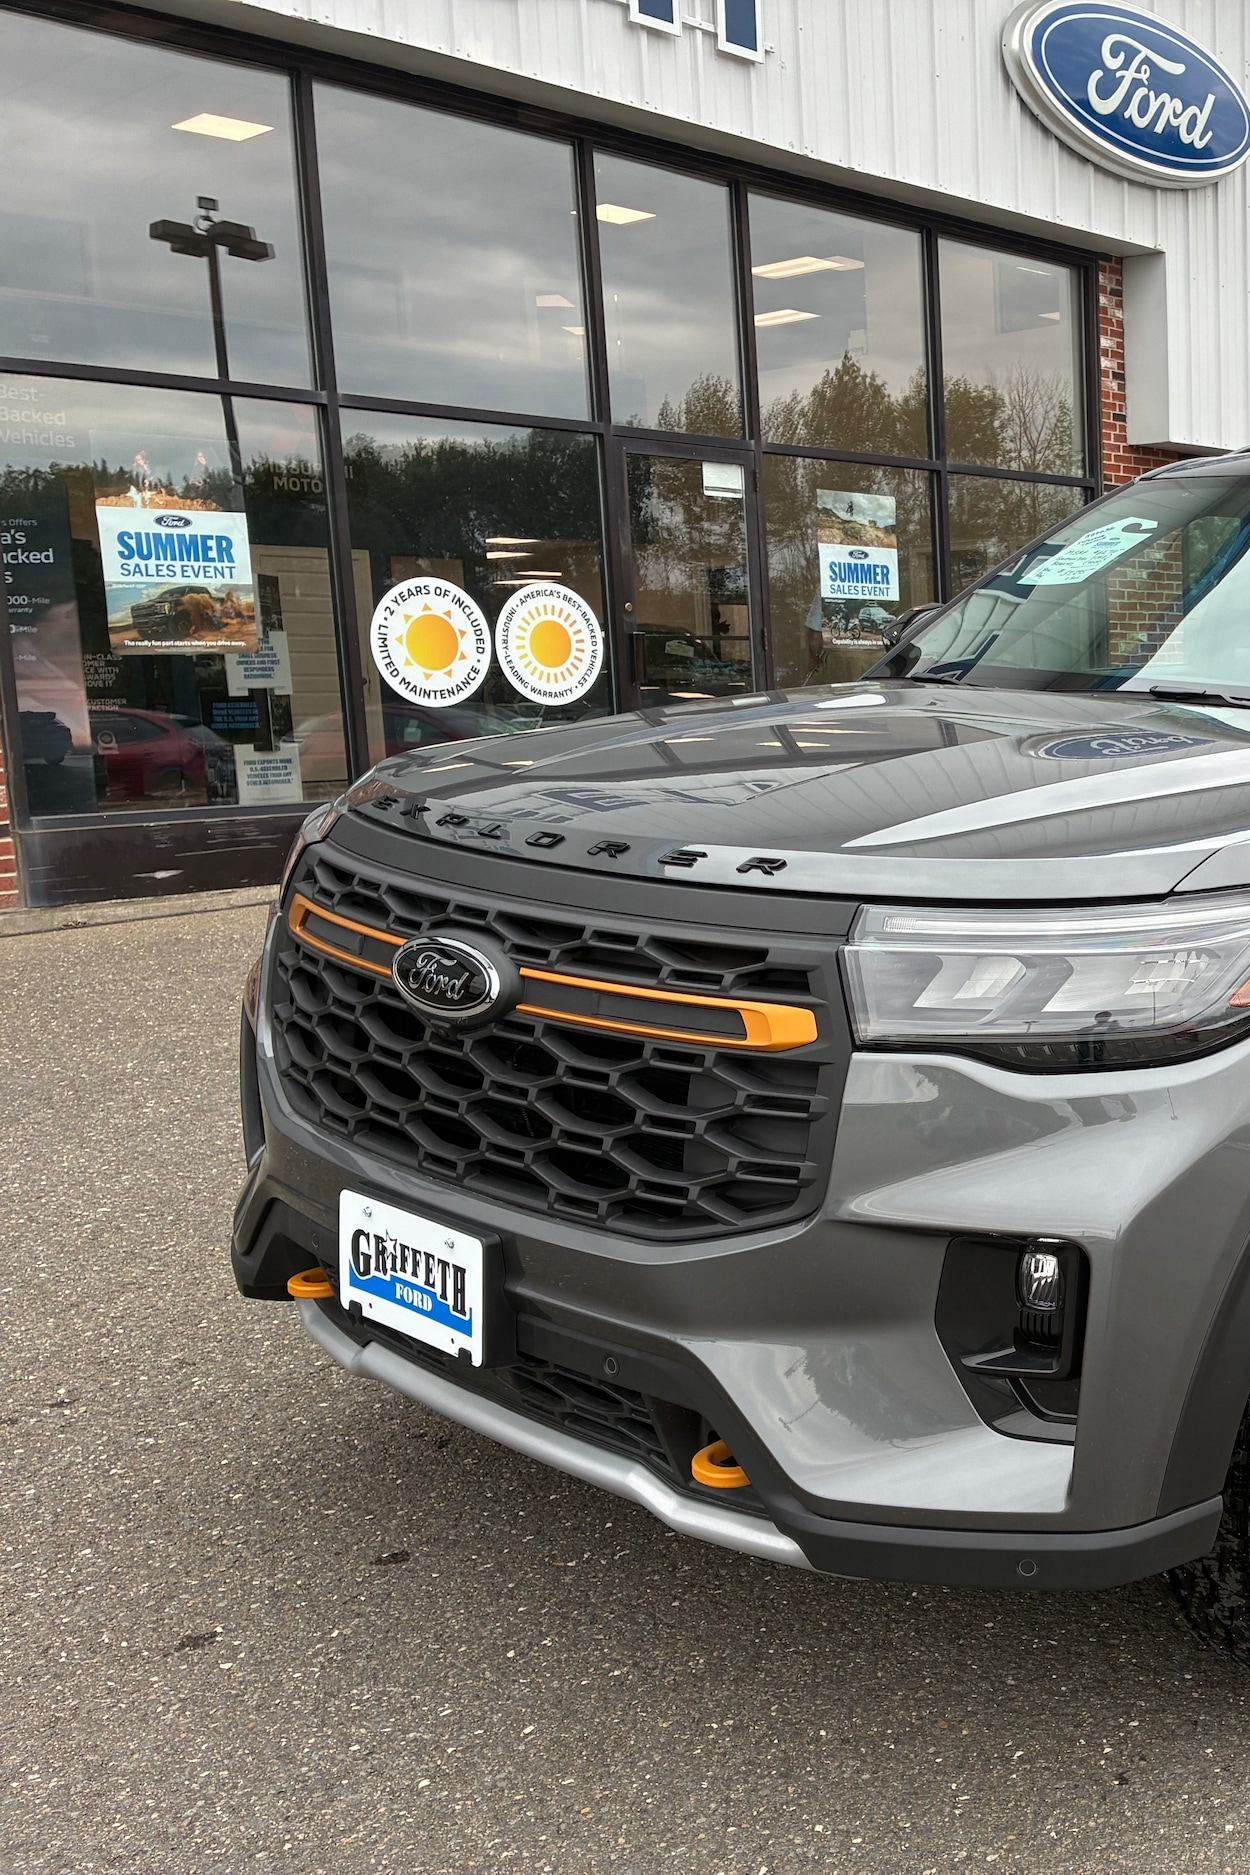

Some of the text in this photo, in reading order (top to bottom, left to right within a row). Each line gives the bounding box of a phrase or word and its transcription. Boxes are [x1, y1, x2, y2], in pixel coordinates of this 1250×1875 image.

[1086, 33, 1215, 150] Ford
[0, 429, 76, 448] Vehicles
[161, 515, 187, 528] Ford
[117, 531, 235, 563] SUMMER
[120, 564, 236, 580] SALES EVENT
[829, 561, 890, 585] SUMMER
[830, 584, 890, 597] SALES EVENT
[386, 584, 485, 655] 2 YEARS OF INCLUDED
[518, 589, 599, 688] AMERICA'S BEST-BACKED VEHICLES
[377, 624, 481, 701] LIMITED MAINTENANCE
[501, 606, 575, 700] INDUSTRY-LEADING WARRANTY
[371, 795, 788, 876] EXPLORER
[408, 951, 470, 1000] Ford
[351, 1228, 467, 1316] GRIFFETH
[394, 1282, 433, 1312] FORD
